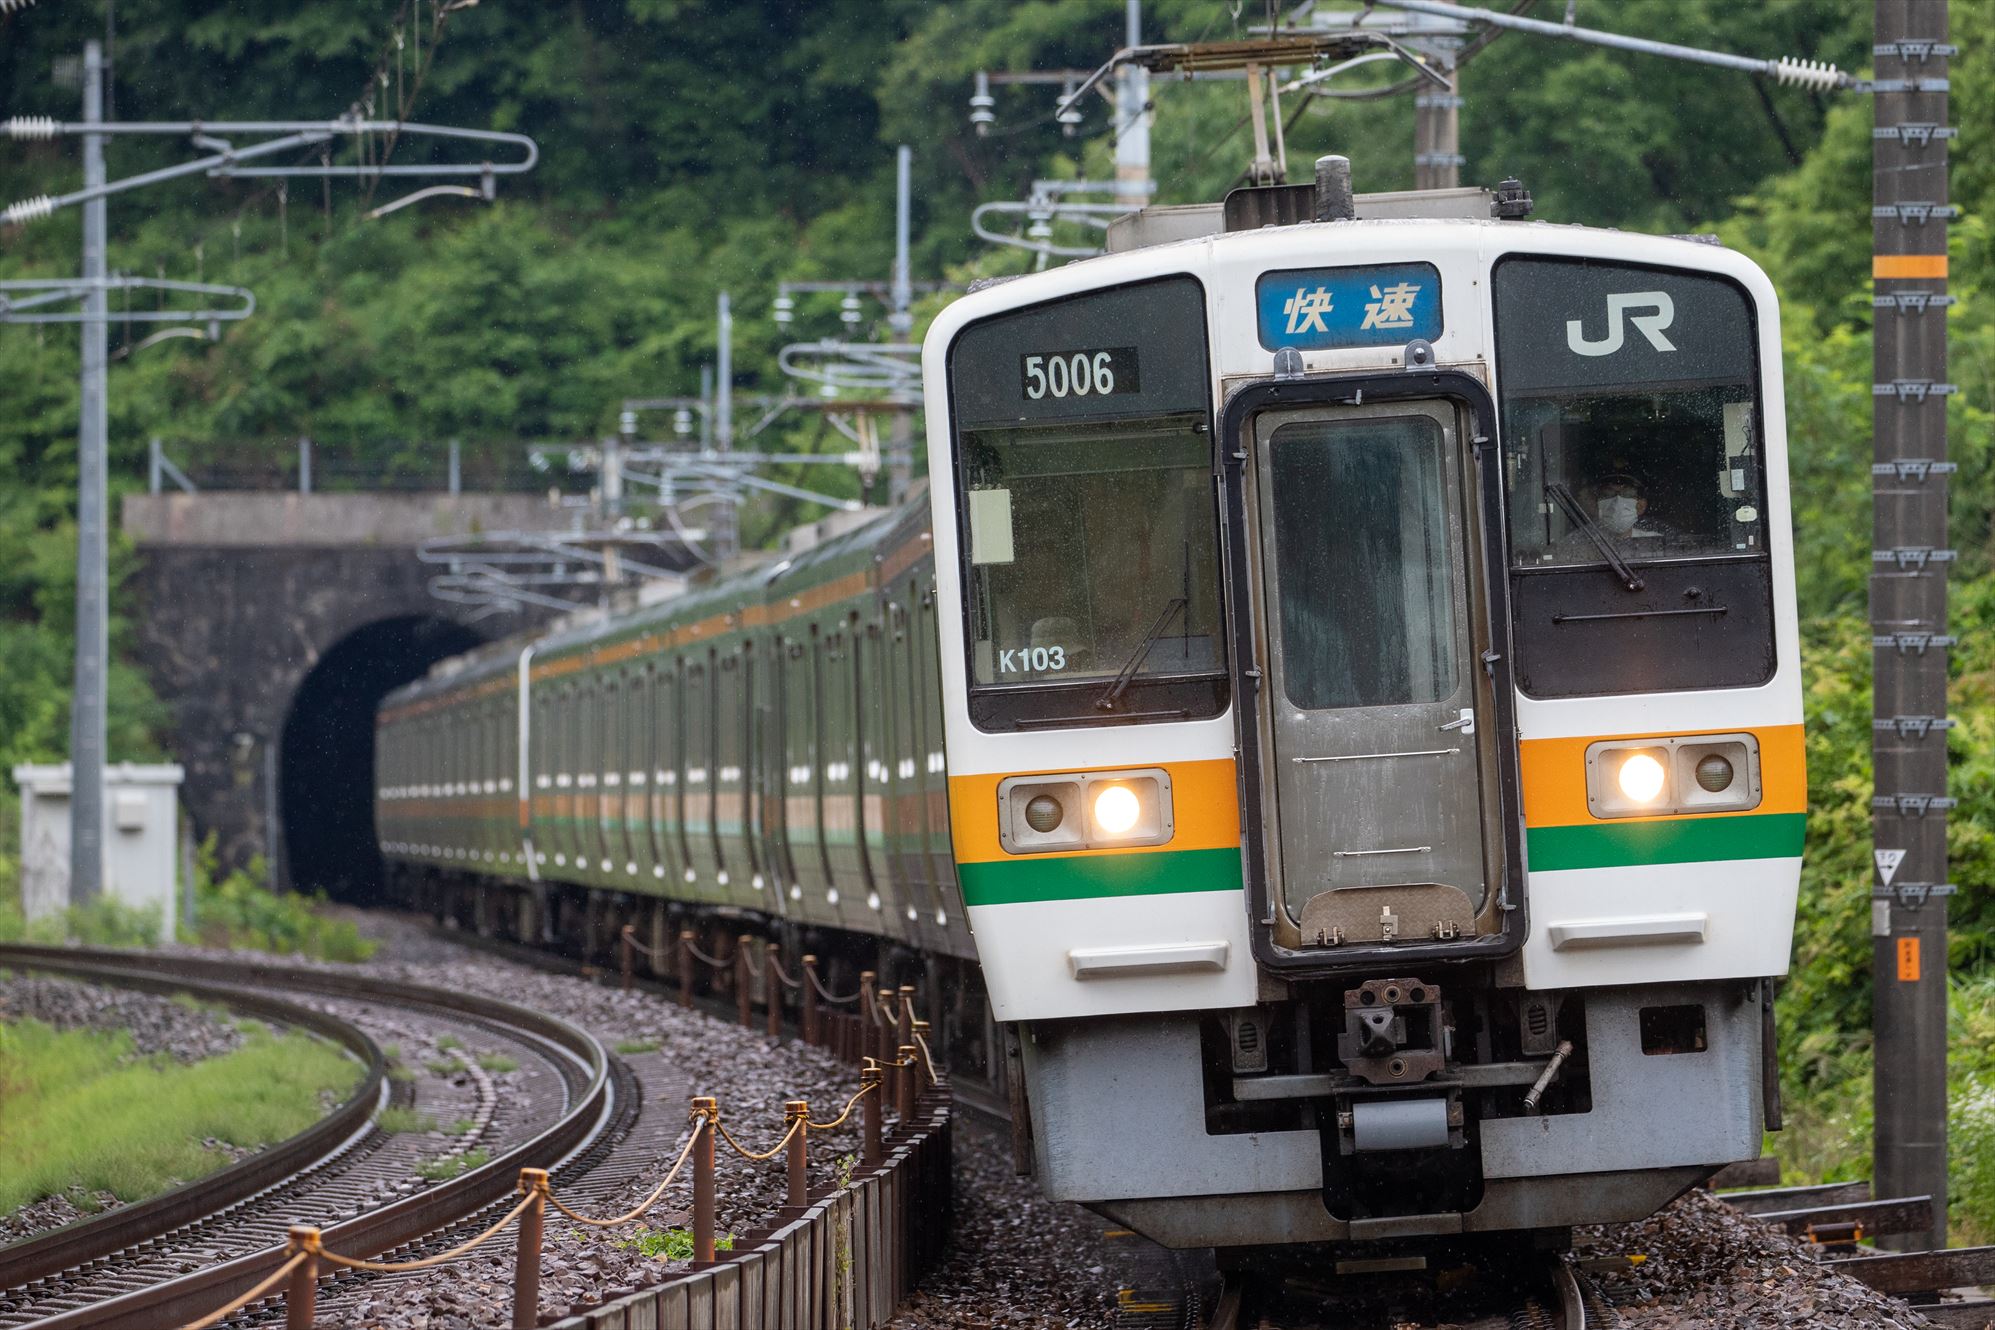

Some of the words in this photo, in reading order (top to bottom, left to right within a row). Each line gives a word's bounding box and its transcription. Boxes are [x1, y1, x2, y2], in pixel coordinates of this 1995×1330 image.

[1283, 282, 1422, 334] 快速
[1566, 291, 1677, 356] JR
[1026, 351, 1114, 399] 5006
[999, 645, 1066, 673] K103
